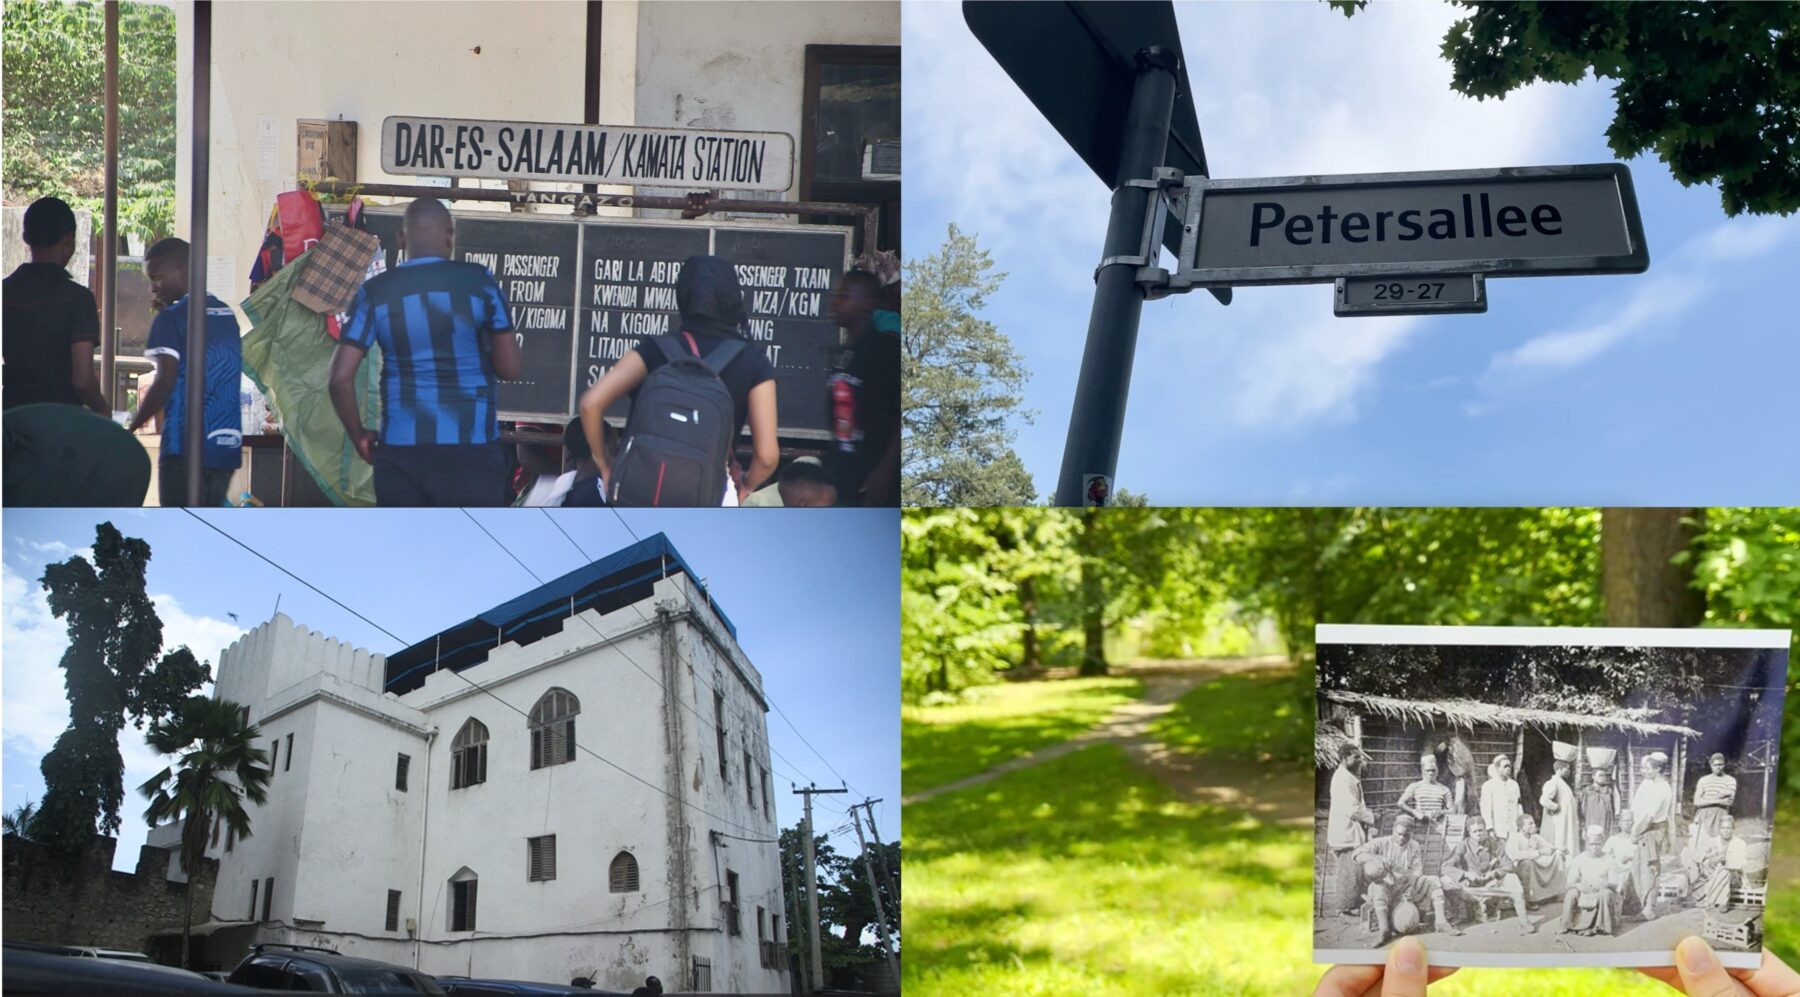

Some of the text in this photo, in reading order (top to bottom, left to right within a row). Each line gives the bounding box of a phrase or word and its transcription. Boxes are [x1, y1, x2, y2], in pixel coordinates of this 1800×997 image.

[693, 136, 766, 184] STATION
[510, 191, 634, 209] TANGAZO
[1249, 192, 1563, 247] Petersallee
[503, 254, 560, 278] PASSENGER
[594, 258, 685, 285] GARI LA ABIR
[794, 267, 831, 290] TRAIN
[510, 280, 546, 303] FROM
[593, 284, 679, 310] KWENDA MWAN
[752, 287, 821, 317] MZA/KGM
[1373, 282, 1446, 301] 29-27
[511, 307, 566, 330] A/KIGOMA
[591, 310, 669, 336] NA KIGOMA
